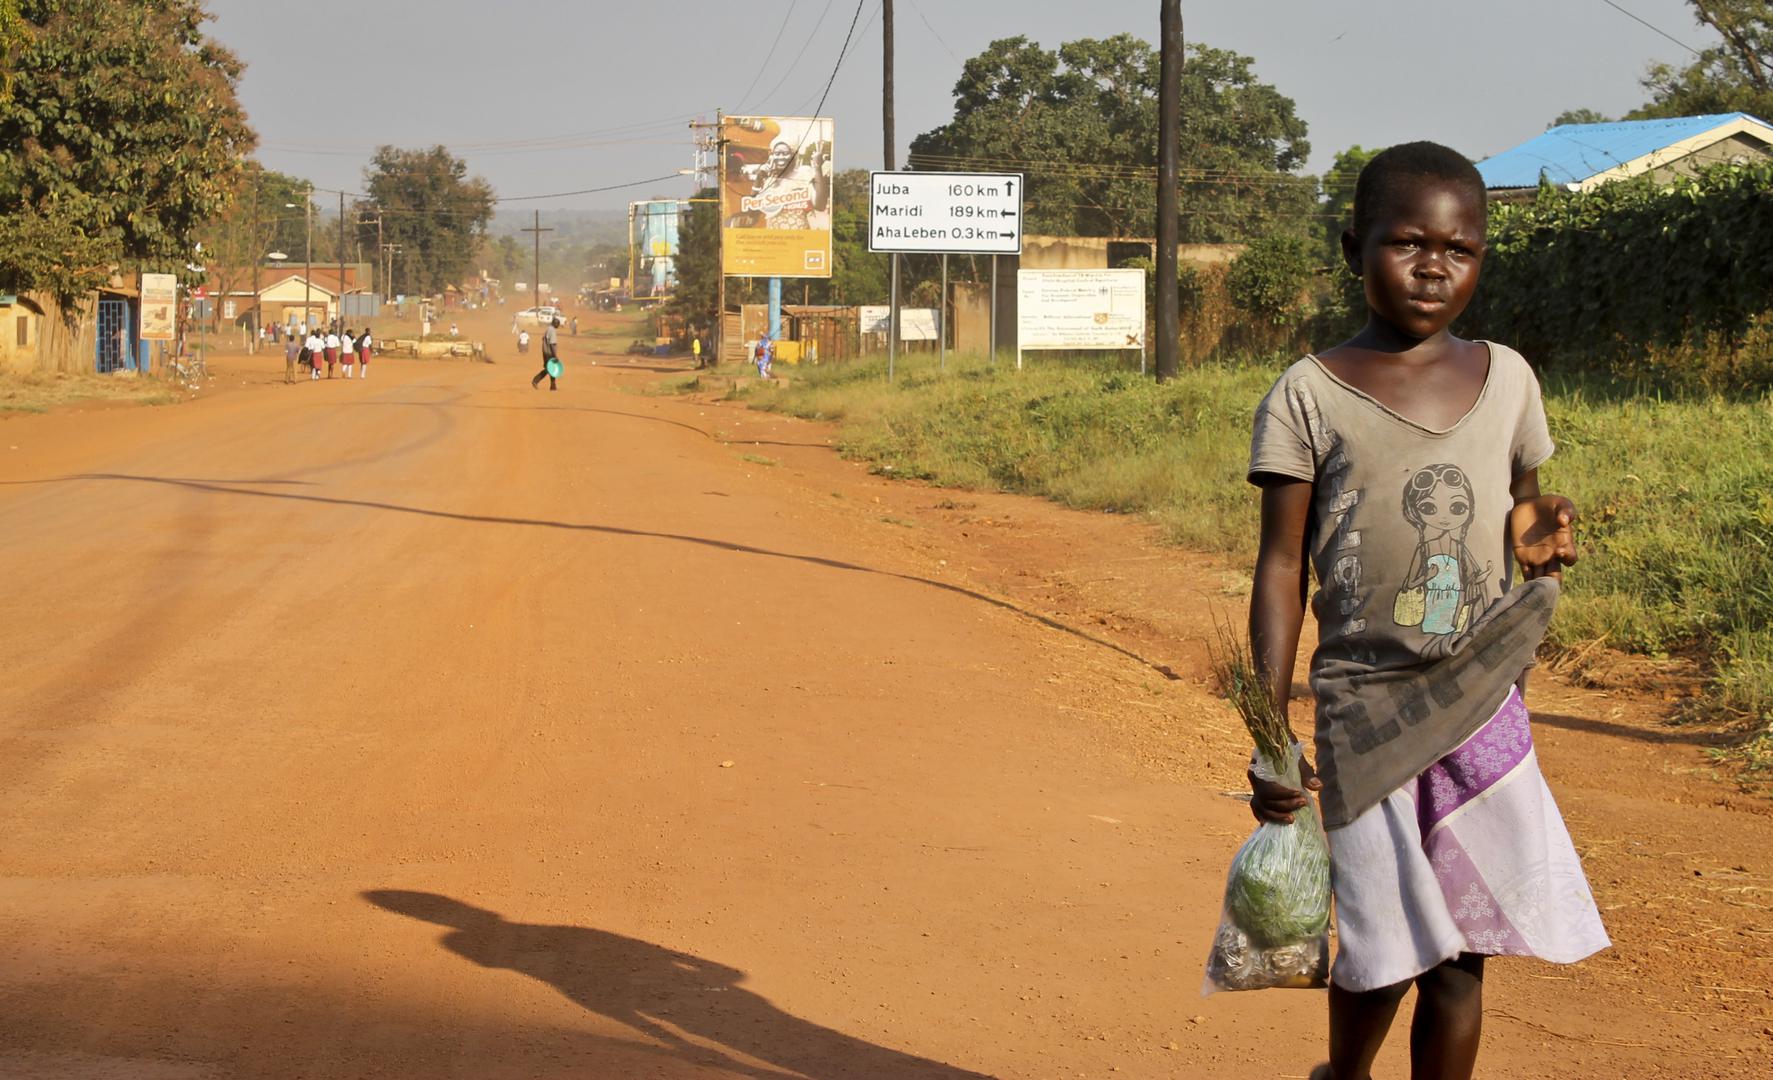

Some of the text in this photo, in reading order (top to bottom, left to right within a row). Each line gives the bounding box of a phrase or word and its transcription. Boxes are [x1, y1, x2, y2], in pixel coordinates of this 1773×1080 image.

[876, 183, 999, 197] Juba 160 km
[743, 188, 809, 211] Per Second
[875, 204, 998, 218] Maridi 189 km
[951, 227, 974, 239] 0.3
[976, 227, 998, 240] km
